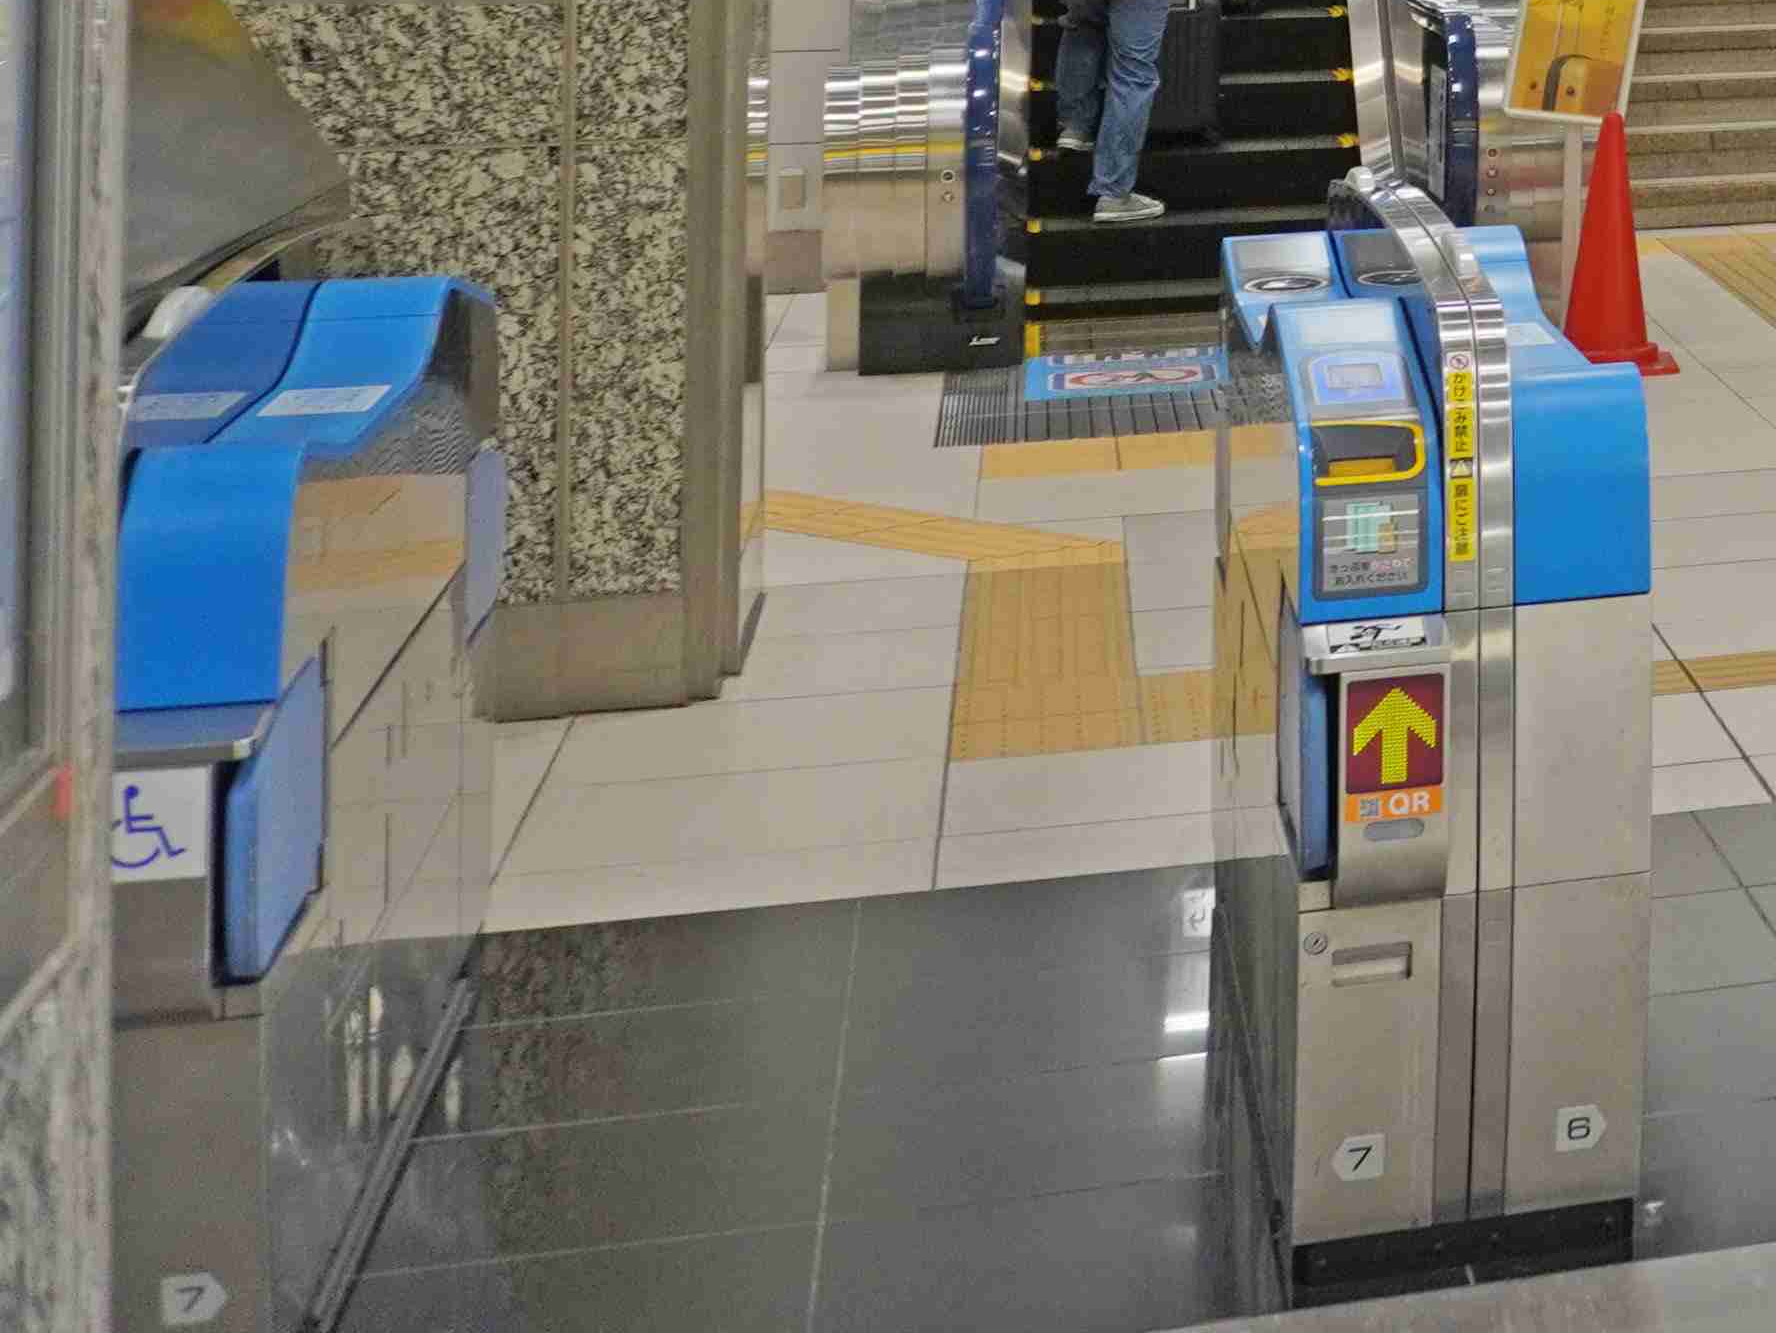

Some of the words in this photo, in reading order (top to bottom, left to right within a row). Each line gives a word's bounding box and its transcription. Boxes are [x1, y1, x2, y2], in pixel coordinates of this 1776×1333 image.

[1388, 792, 1431, 814] QR
[1567, 1116, 1591, 1140] 6
[1347, 1146, 1373, 1172] 7
[176, 1285, 205, 1312] 7
